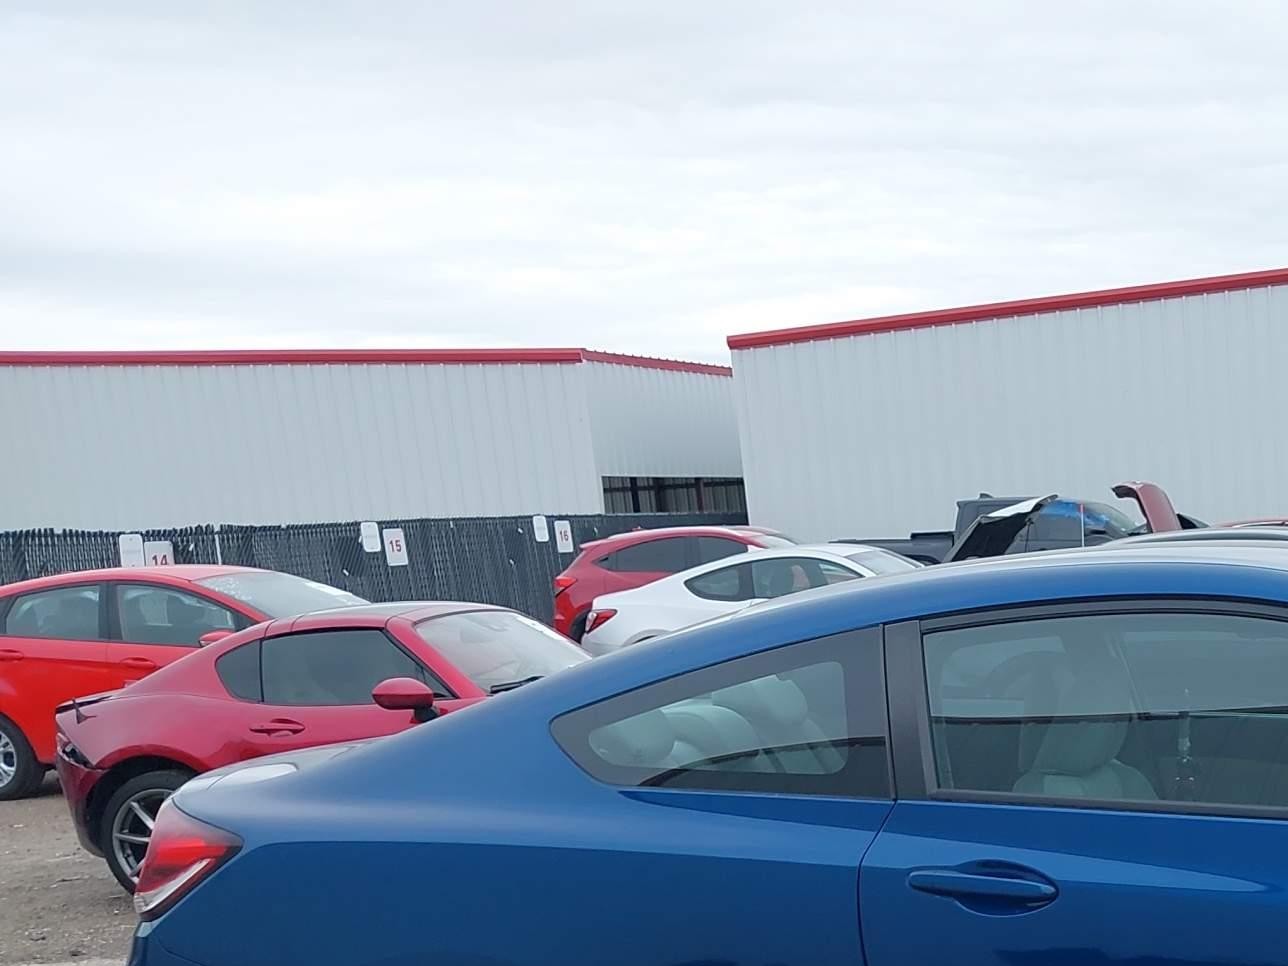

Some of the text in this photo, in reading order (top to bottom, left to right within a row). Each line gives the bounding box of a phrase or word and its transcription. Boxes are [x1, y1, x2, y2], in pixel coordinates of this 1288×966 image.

[560, 530, 569, 542] 16
[389, 540, 402, 552] 15
[152, 555, 168, 566] 14
